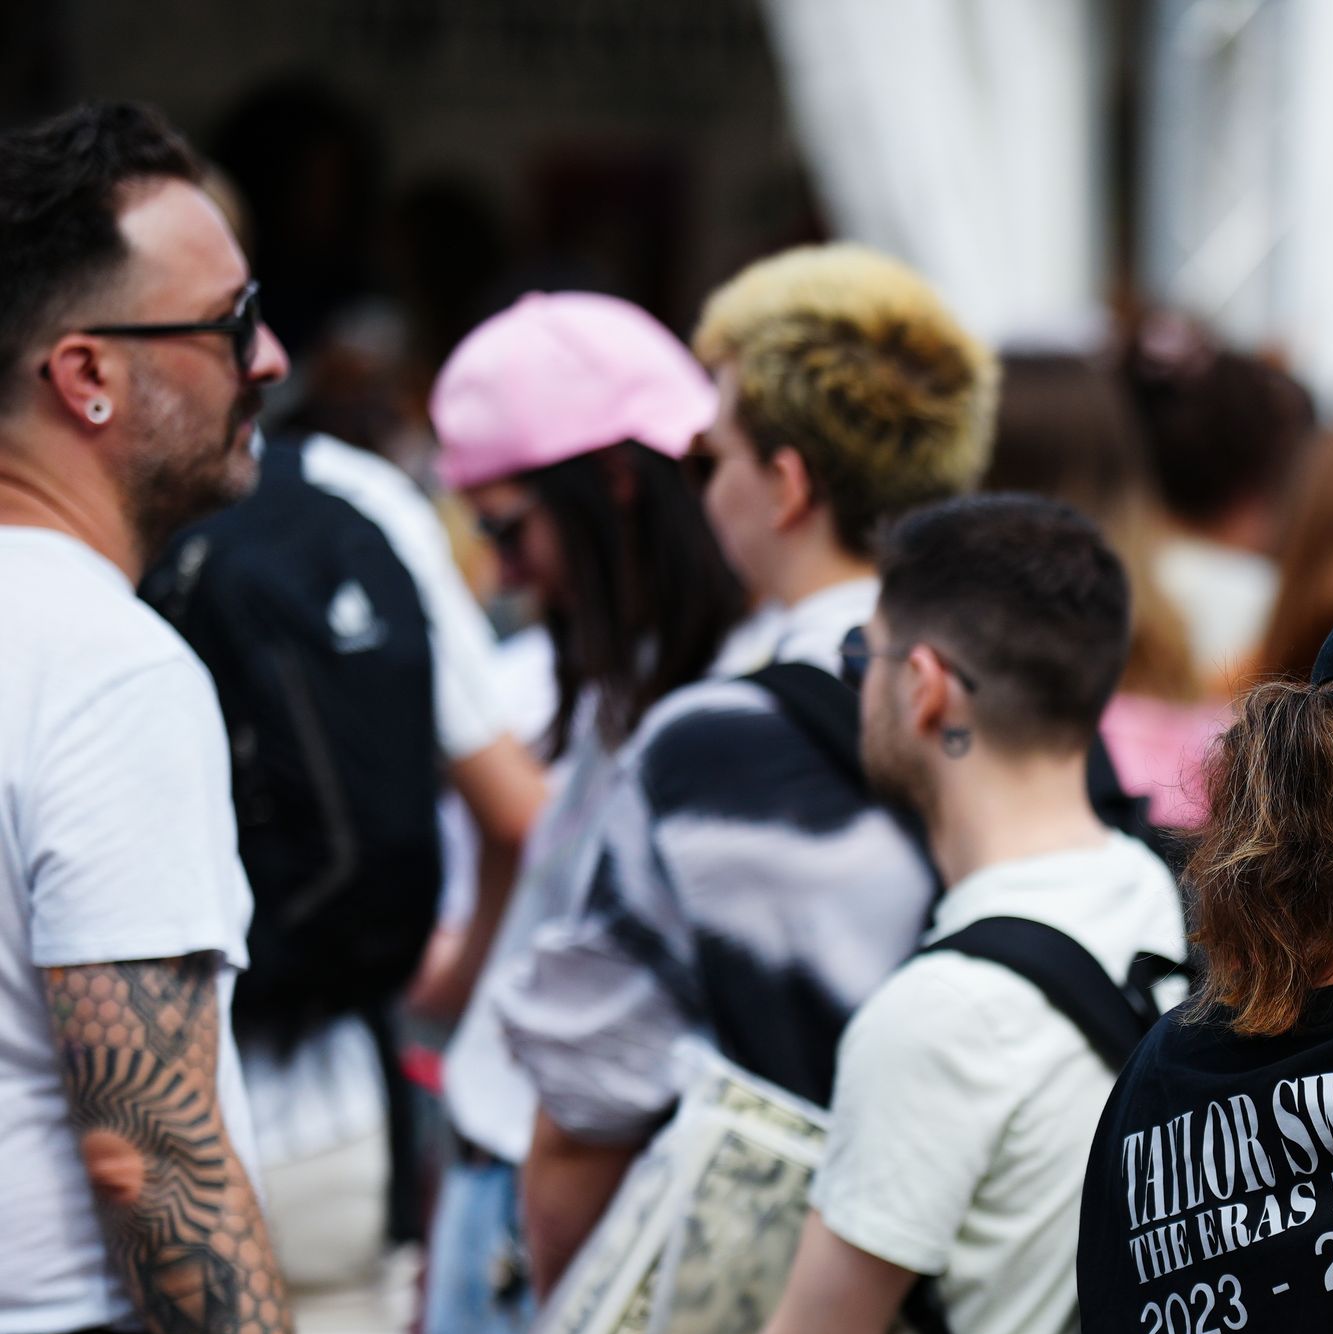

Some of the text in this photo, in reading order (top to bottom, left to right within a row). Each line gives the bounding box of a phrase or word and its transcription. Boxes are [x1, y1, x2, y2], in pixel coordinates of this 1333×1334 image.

[1121, 1094, 1276, 1230] TAYLOR
[1129, 1223, 1190, 1285] THE
[1200, 1181, 1318, 1262] ERAS
